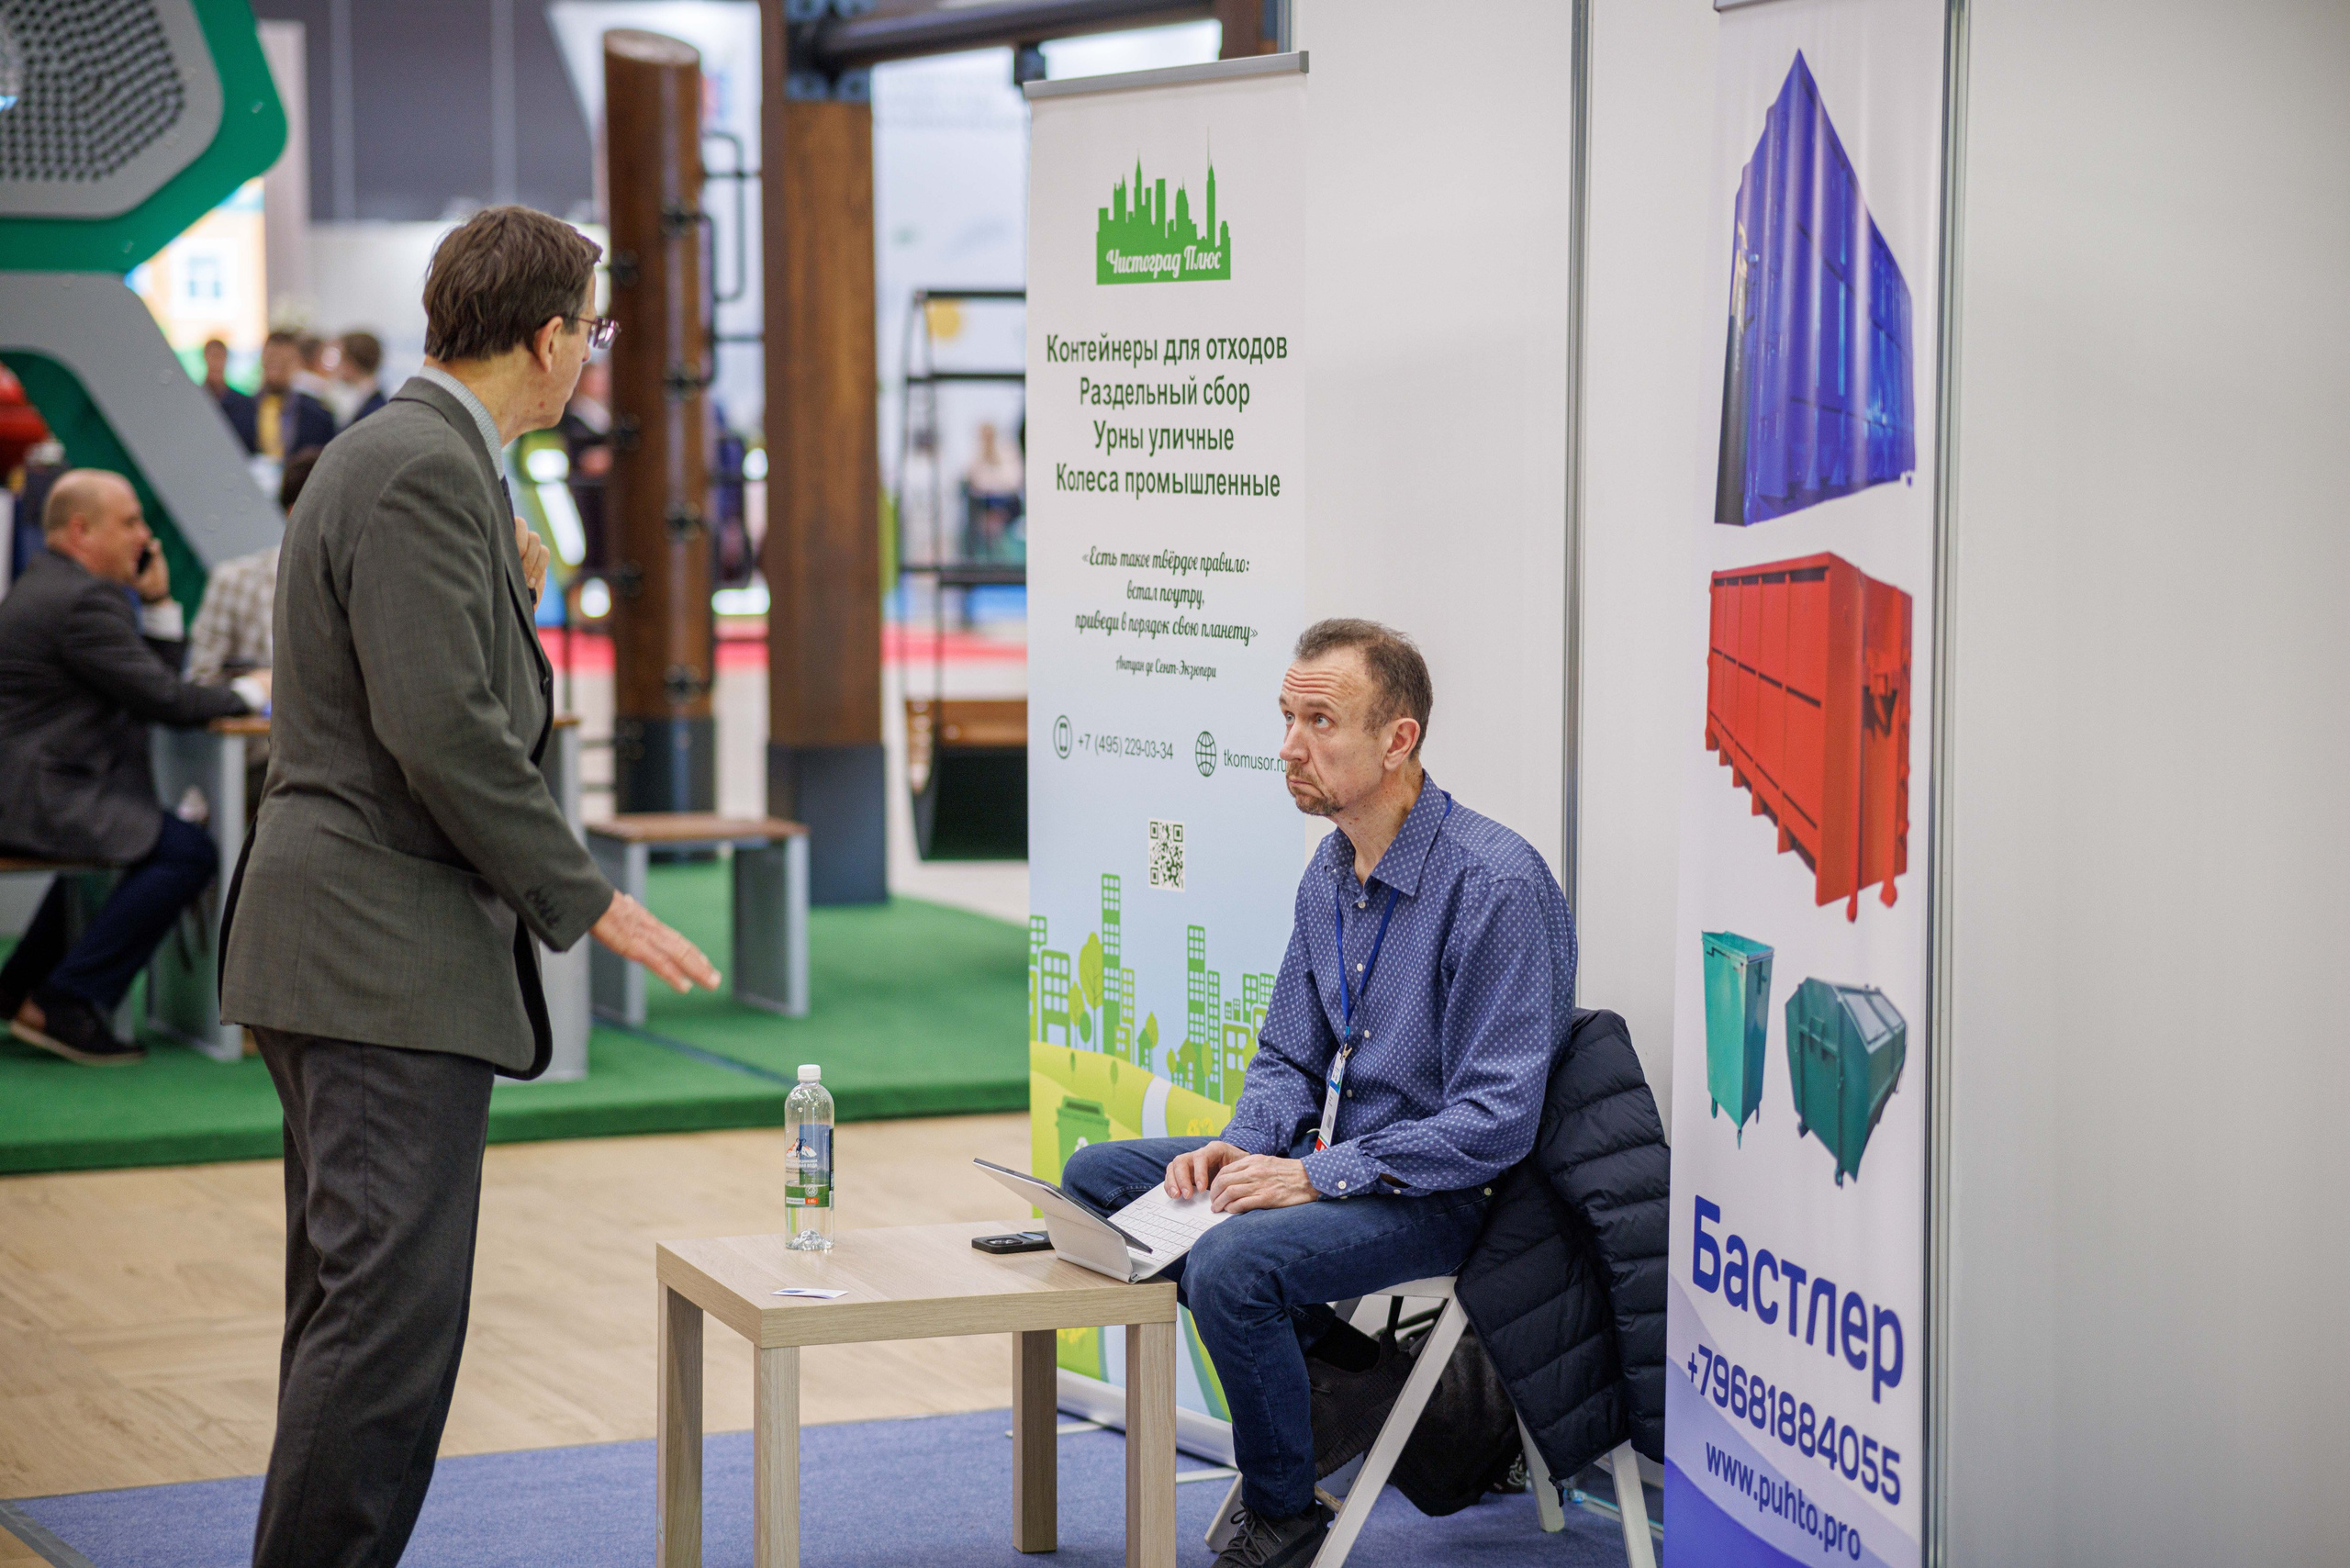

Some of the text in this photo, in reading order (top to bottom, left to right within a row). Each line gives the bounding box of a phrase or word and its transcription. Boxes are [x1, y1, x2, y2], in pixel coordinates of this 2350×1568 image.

[1106, 245, 1222, 279] Чистоград Плюс
[1046, 332, 1288, 368] Контейнеры для отходов
[1080, 375, 1250, 413] Раздельный сбор
[1093, 420, 1235, 457] Урны уличные
[1056, 463, 1281, 500] Колеса промышленные
[1081, 545, 1250, 577] «Есть такое твёрдое правило:
[1126, 579, 1205, 610] встал поутру,
[1075, 610, 1259, 647] приведи в порядок свою планету»
[1115, 655, 1217, 681] Антуан де Сент-Экзюпери
[1077, 734, 1174, 760] +7 (495) 229-03-34
[1223, 748, 1287, 773] tkomusor.ru
[1692, 1193, 1905, 1405] Бастлер
[1687, 1343, 1901, 1506] +79681884055
[1706, 1441, 1862, 1562] www.puhto.pro
